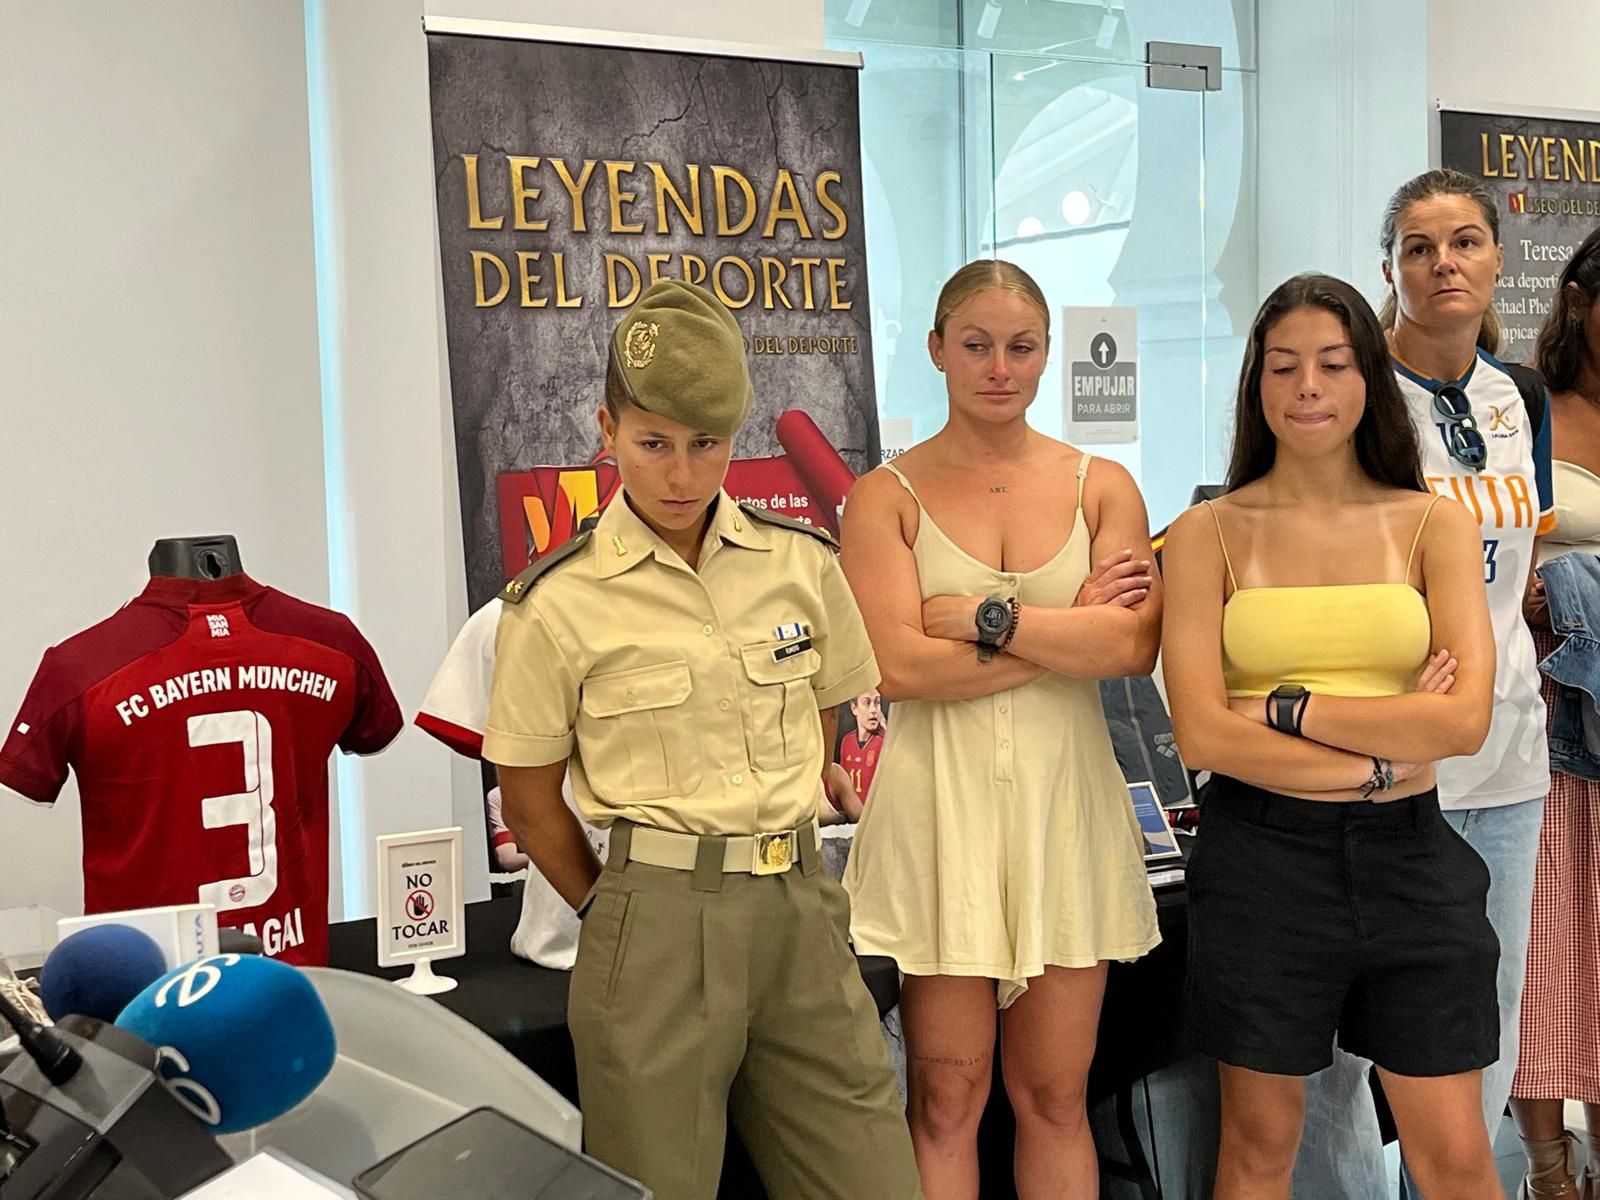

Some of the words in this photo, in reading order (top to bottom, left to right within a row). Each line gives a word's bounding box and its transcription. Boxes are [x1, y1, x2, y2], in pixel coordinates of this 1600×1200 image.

[461, 153, 848, 240] LEYENDAS
[1562, 199, 1584, 215] DEL
[1520, 239, 1574, 261] Teresa
[470, 250, 583, 309] DEL
[755, 337, 783, 354] DEL
[788, 338, 858, 355] DEPORTE
[1074, 375, 1135, 396] EMPUJAR
[1077, 403, 1102, 415] PARA
[1104, 403, 1132, 414] ABRIR
[770, 493, 786, 509] de
[789, 493, 808, 508] las
[116, 694, 150, 726] FC
[149, 667, 231, 710] BAYERN
[238, 665, 337, 702] MÜNCHEN
[187, 710, 277, 912] 3
[406, 873, 432, 889] NO
[392, 919, 449, 940] TOCAR
